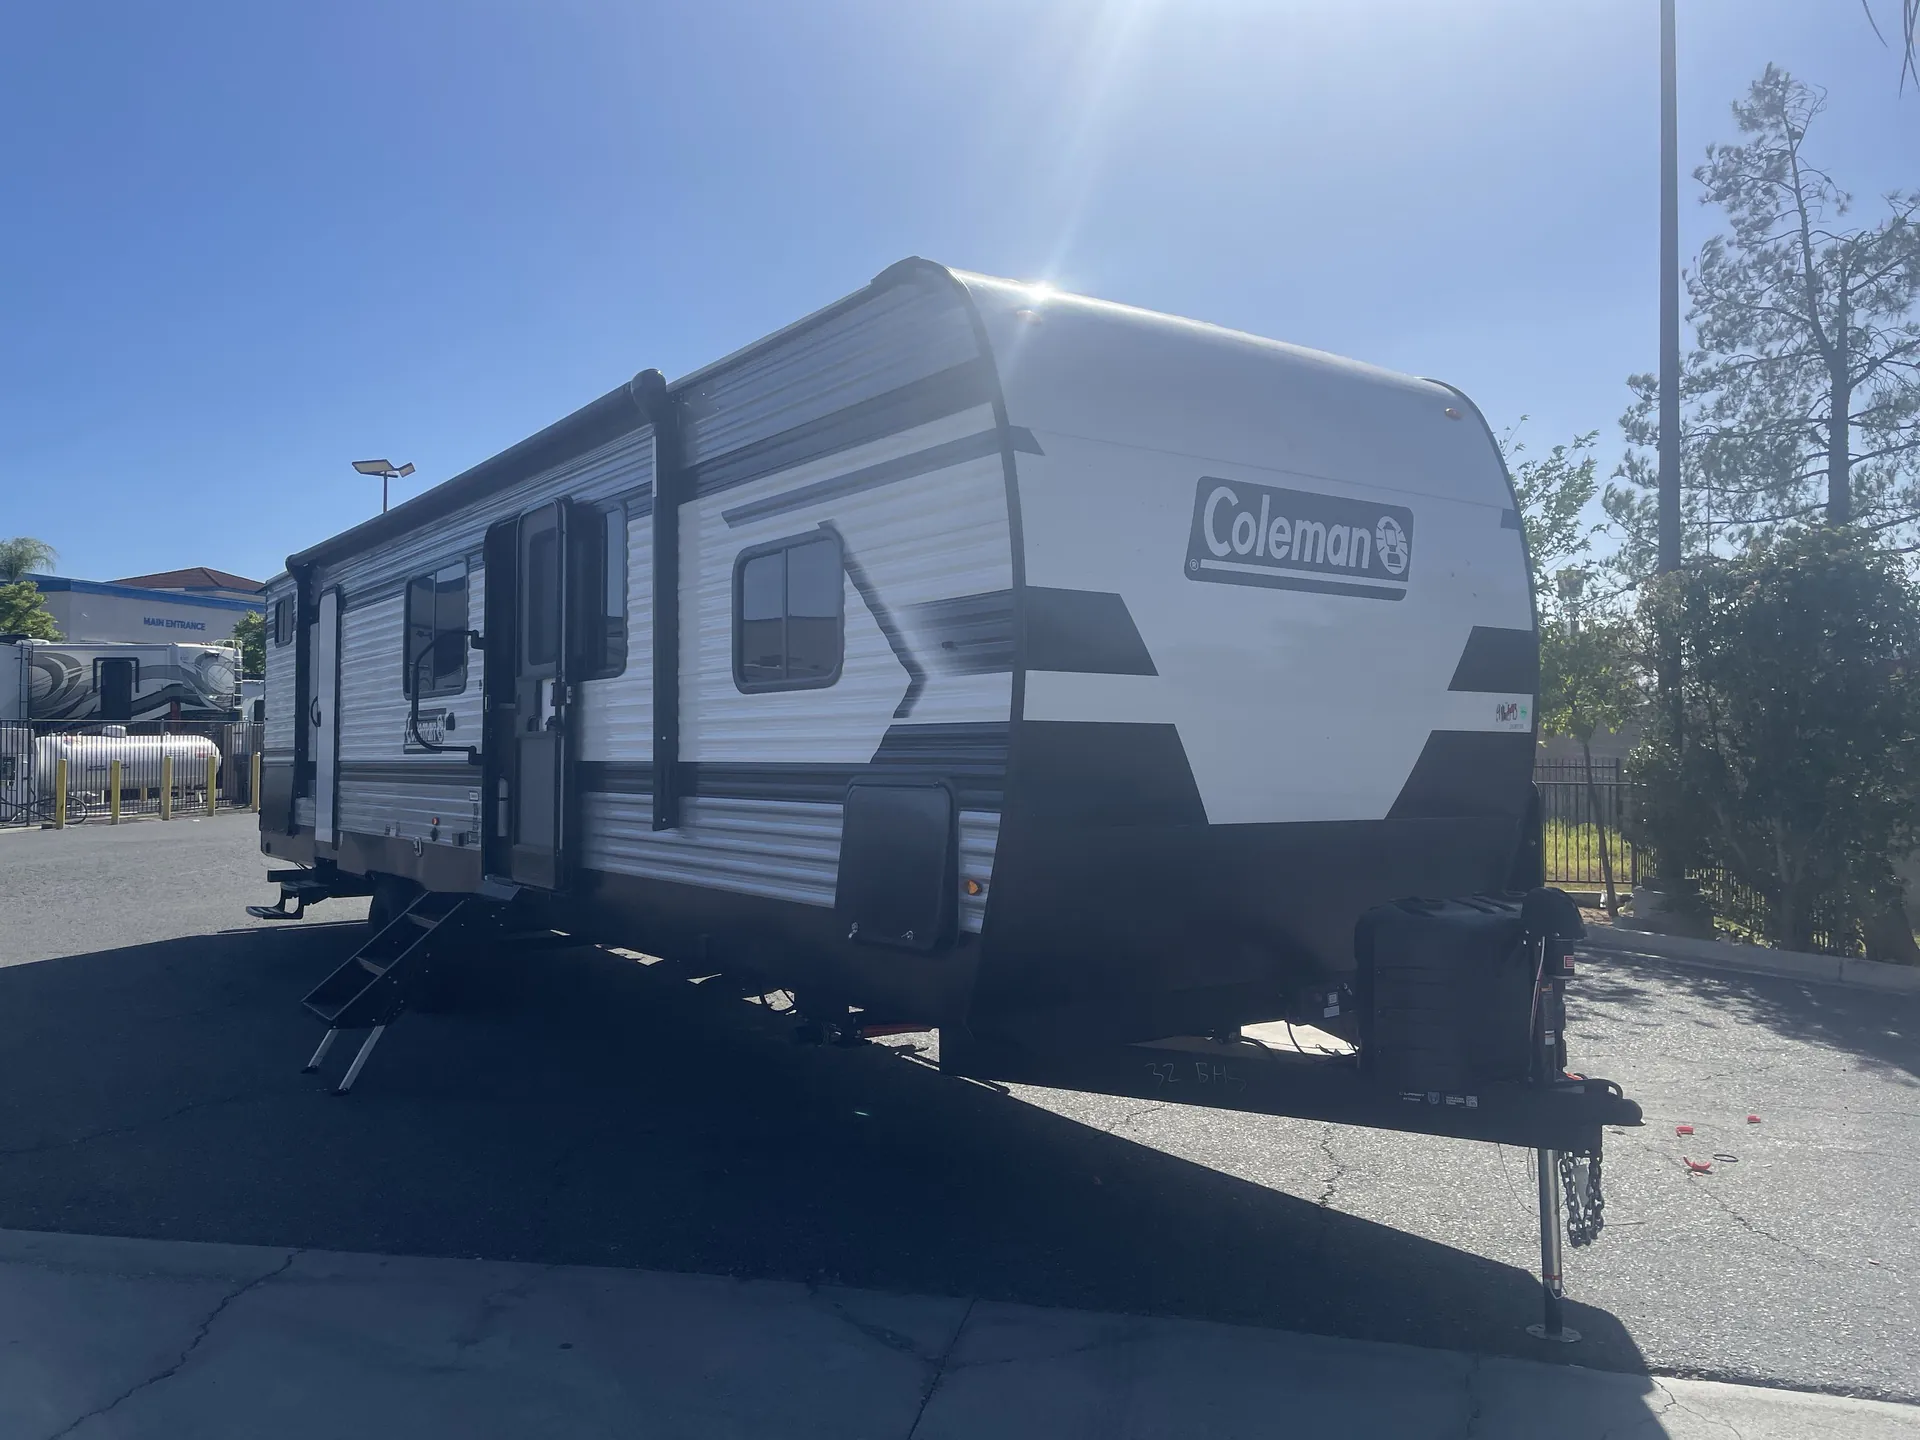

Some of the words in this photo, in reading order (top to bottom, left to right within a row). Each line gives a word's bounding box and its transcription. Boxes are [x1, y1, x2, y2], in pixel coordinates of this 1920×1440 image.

[1204, 486, 1372, 569] Coleman
[143, 617, 164, 627] MAIN
[165, 619, 206, 631] ENTRANCE
[1144, 1062, 1180, 1091] 32
